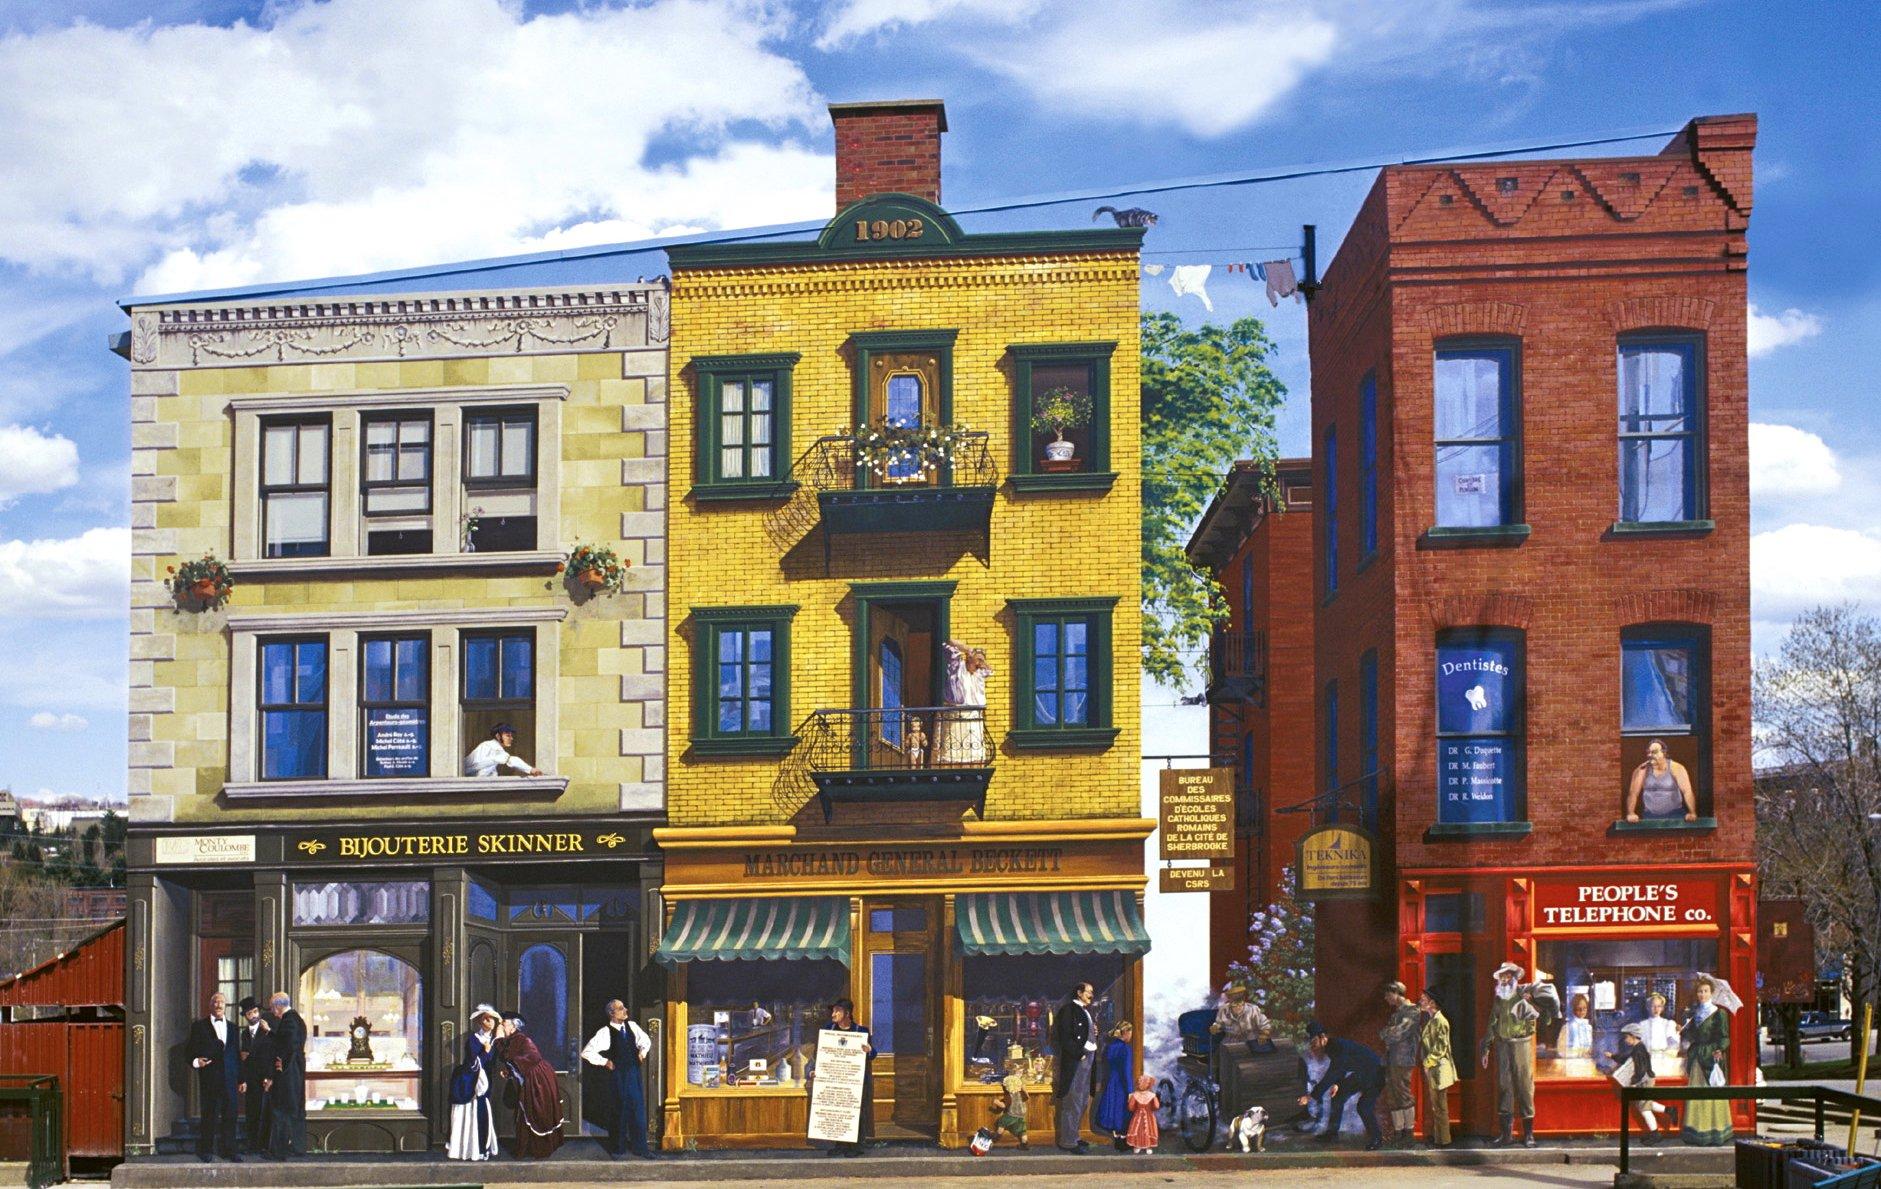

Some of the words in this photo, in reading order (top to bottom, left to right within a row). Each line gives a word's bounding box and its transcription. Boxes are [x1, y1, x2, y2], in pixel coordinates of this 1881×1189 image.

[855, 218, 923, 241] 1902
[1441, 657, 1509, 676] Dentistes
[1448, 747, 1458, 755] DR
[1474, 746, 1502, 756] Duquette
[1448, 762, 1459, 770] DR
[1178, 776, 1213, 785] BUREAU
[1448, 777, 1459, 785] DR
[1187, 785, 1205, 794] DES
[1163, 794, 1232, 804] COMMISSAIRES
[1448, 792, 1459, 801] DR
[1167, 814, 1227, 823] CATHOLIQUES
[1176, 823, 1218, 832] ROMAINS
[1166, 833, 1179, 842] DE
[1180, 833, 1193, 842] LA
[1194, 831, 1215, 842] CITÉ
[1216, 832, 1229, 841] DE
[194, 838, 227, 847] MONTY
[339, 835, 469, 858] BIJOUTERIE
[477, 833, 584, 853] SKINNER
[1166, 841, 1228, 851] SHERBROOKE
[199, 844, 249, 854] COULOMBE
[1304, 849, 1367, 861] TEKNIKA
[743, 852, 860, 878] MARCHAND
[866, 849, 964, 876] GENERAL
[970, 847, 1063, 873] BECKETT
[1170, 870, 1204, 878] DEVENU
[1212, 869, 1225, 877] LA
[1185, 879, 1210, 888] CSRS
[1578, 884, 1678, 902] PEOPLE'S
[1543, 906, 1677, 923] TELEPHONE
